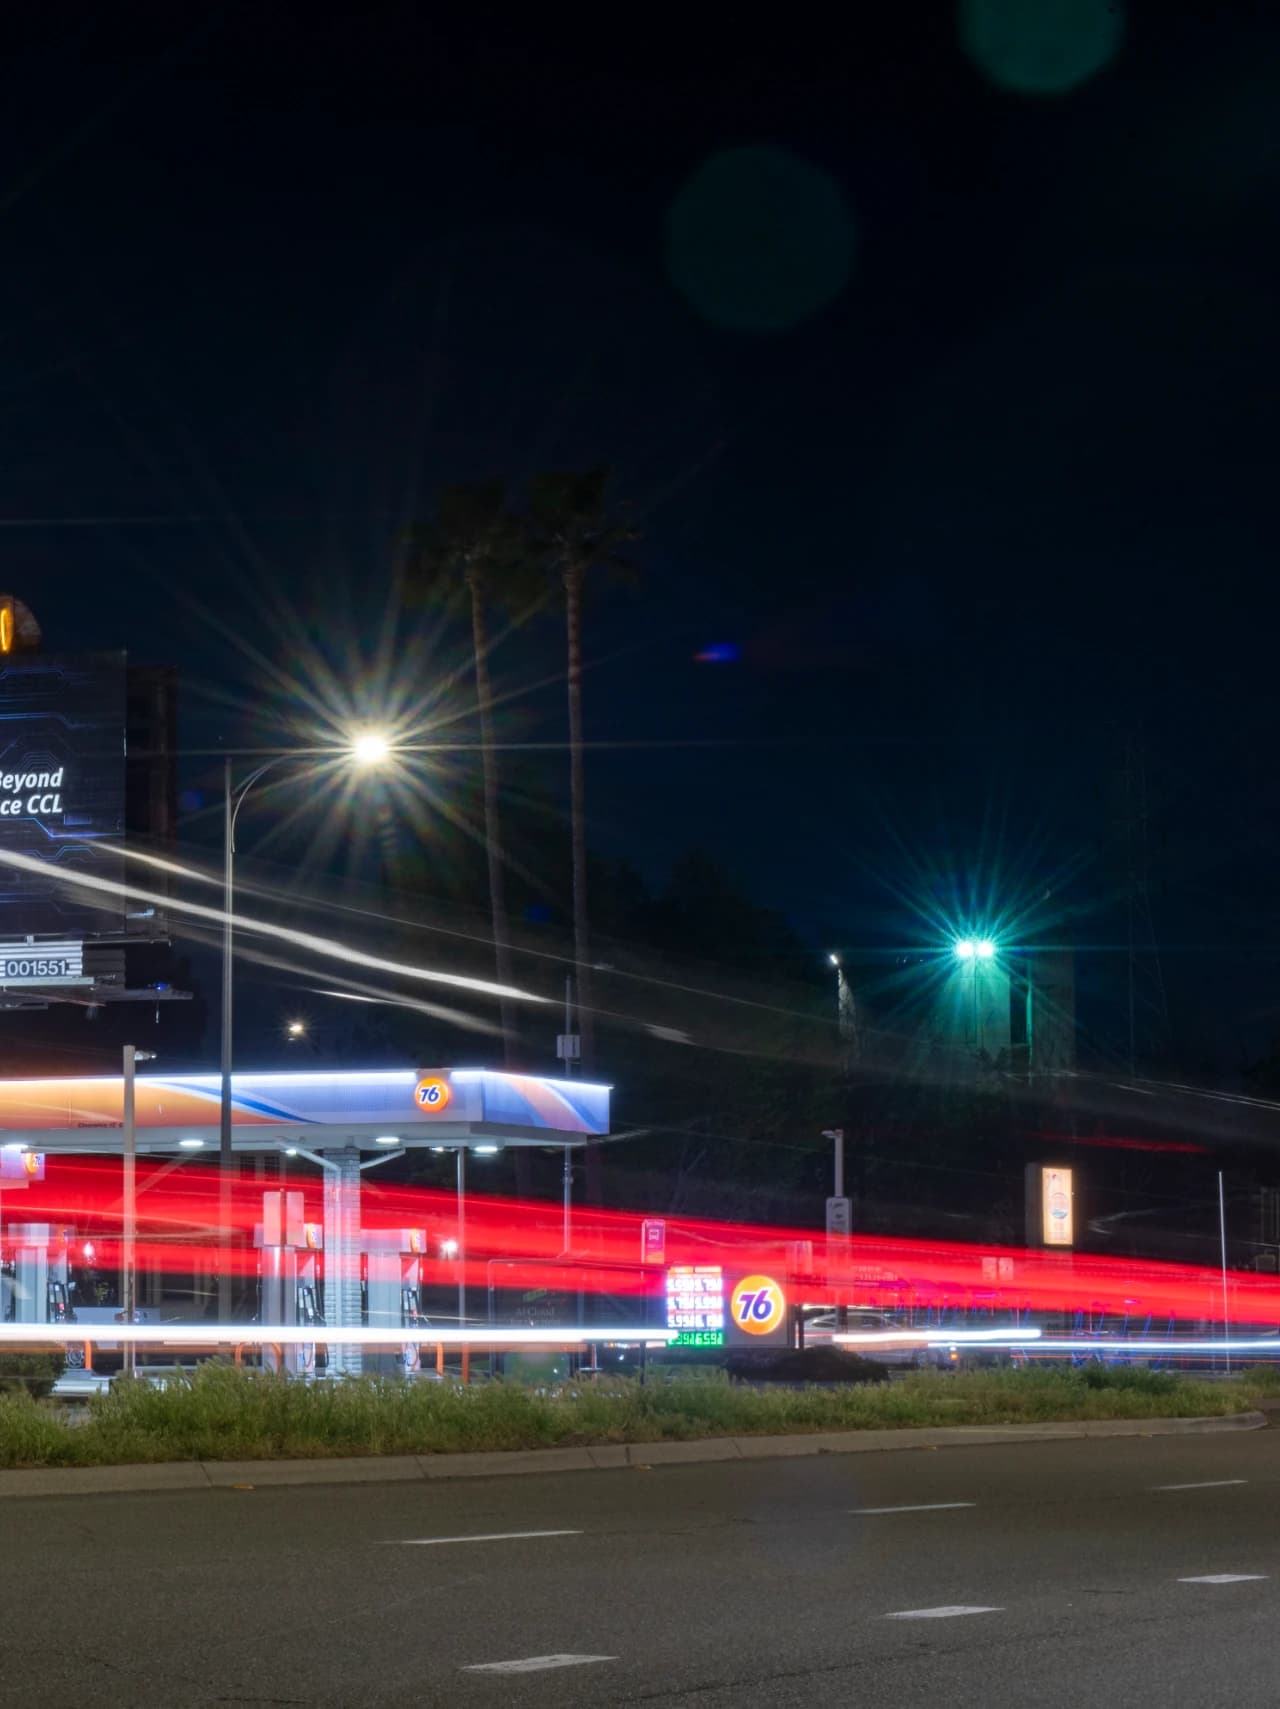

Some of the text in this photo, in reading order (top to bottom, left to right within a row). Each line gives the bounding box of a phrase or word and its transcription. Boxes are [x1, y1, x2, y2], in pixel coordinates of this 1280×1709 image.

[27, 794, 63, 814] CCL
[7, 960, 66, 976] 001551
[421, 1086, 440, 1102] 76
[739, 1289, 773, 1321] 76
